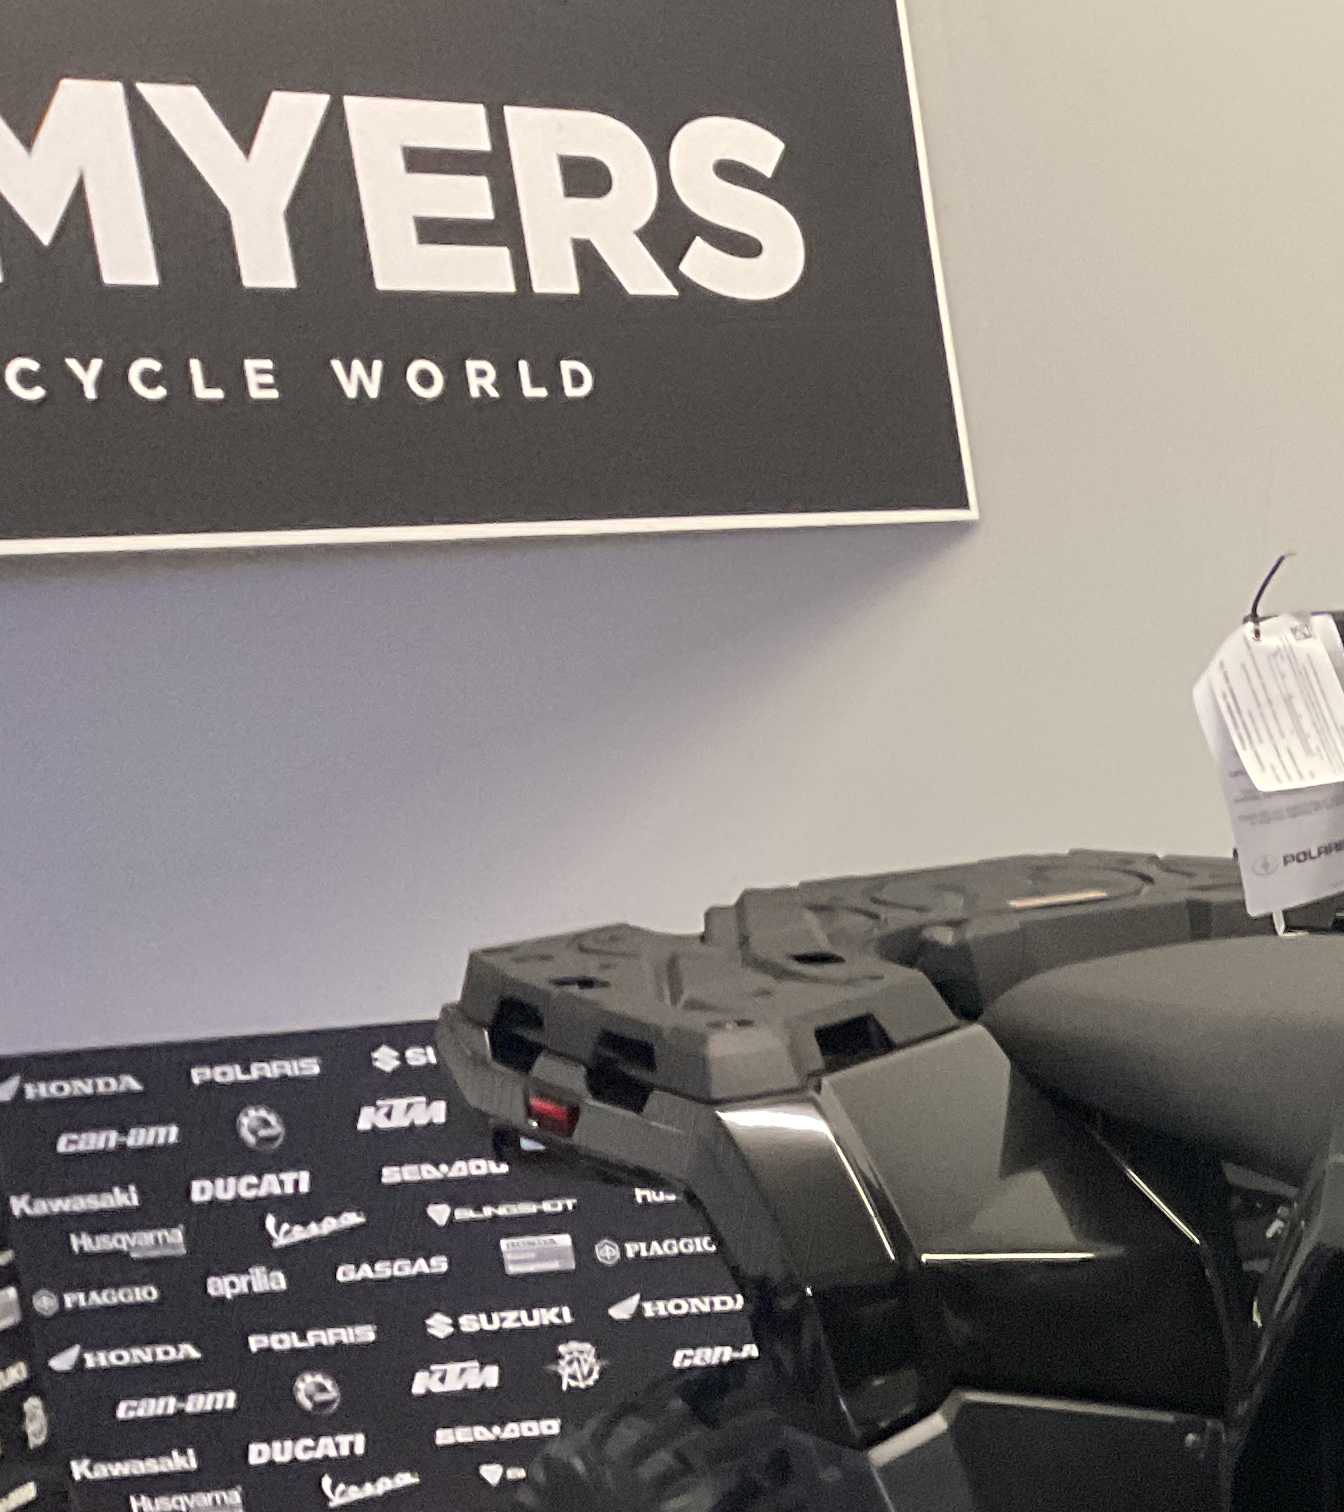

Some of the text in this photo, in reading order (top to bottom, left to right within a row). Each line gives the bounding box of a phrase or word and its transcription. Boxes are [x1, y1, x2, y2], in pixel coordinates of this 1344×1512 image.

[0, 78, 804, 300] MYERS
[4, 356, 595, 401] CYCLE WORLD
[191, 1057, 321, 1085] POLARIS
[23, 1075, 143, 1101] HONDA
[357, 1096, 446, 1131] KTM
[10, 1184, 139, 1218] Kawasaki
[191, 1170, 310, 1203] DUCATI
[265, 1212, 366, 1248] Vespa
[207, 1266, 287, 1299] aprilia
[336, 1255, 448, 1282] GASGAS
[63, 1286, 158, 1310] PIAGGIO
[459, 1306, 574, 1333] SUZUKI
[248, 1324, 377, 1353] POLARIS
[83, 1344, 201, 1369] HONDA
[411, 1360, 499, 1395] KTM
[70, 1448, 198, 1481] Kawasaki
[248, 1432, 365, 1465] DUCATI
[322, 1472, 420, 1508] Vespa
